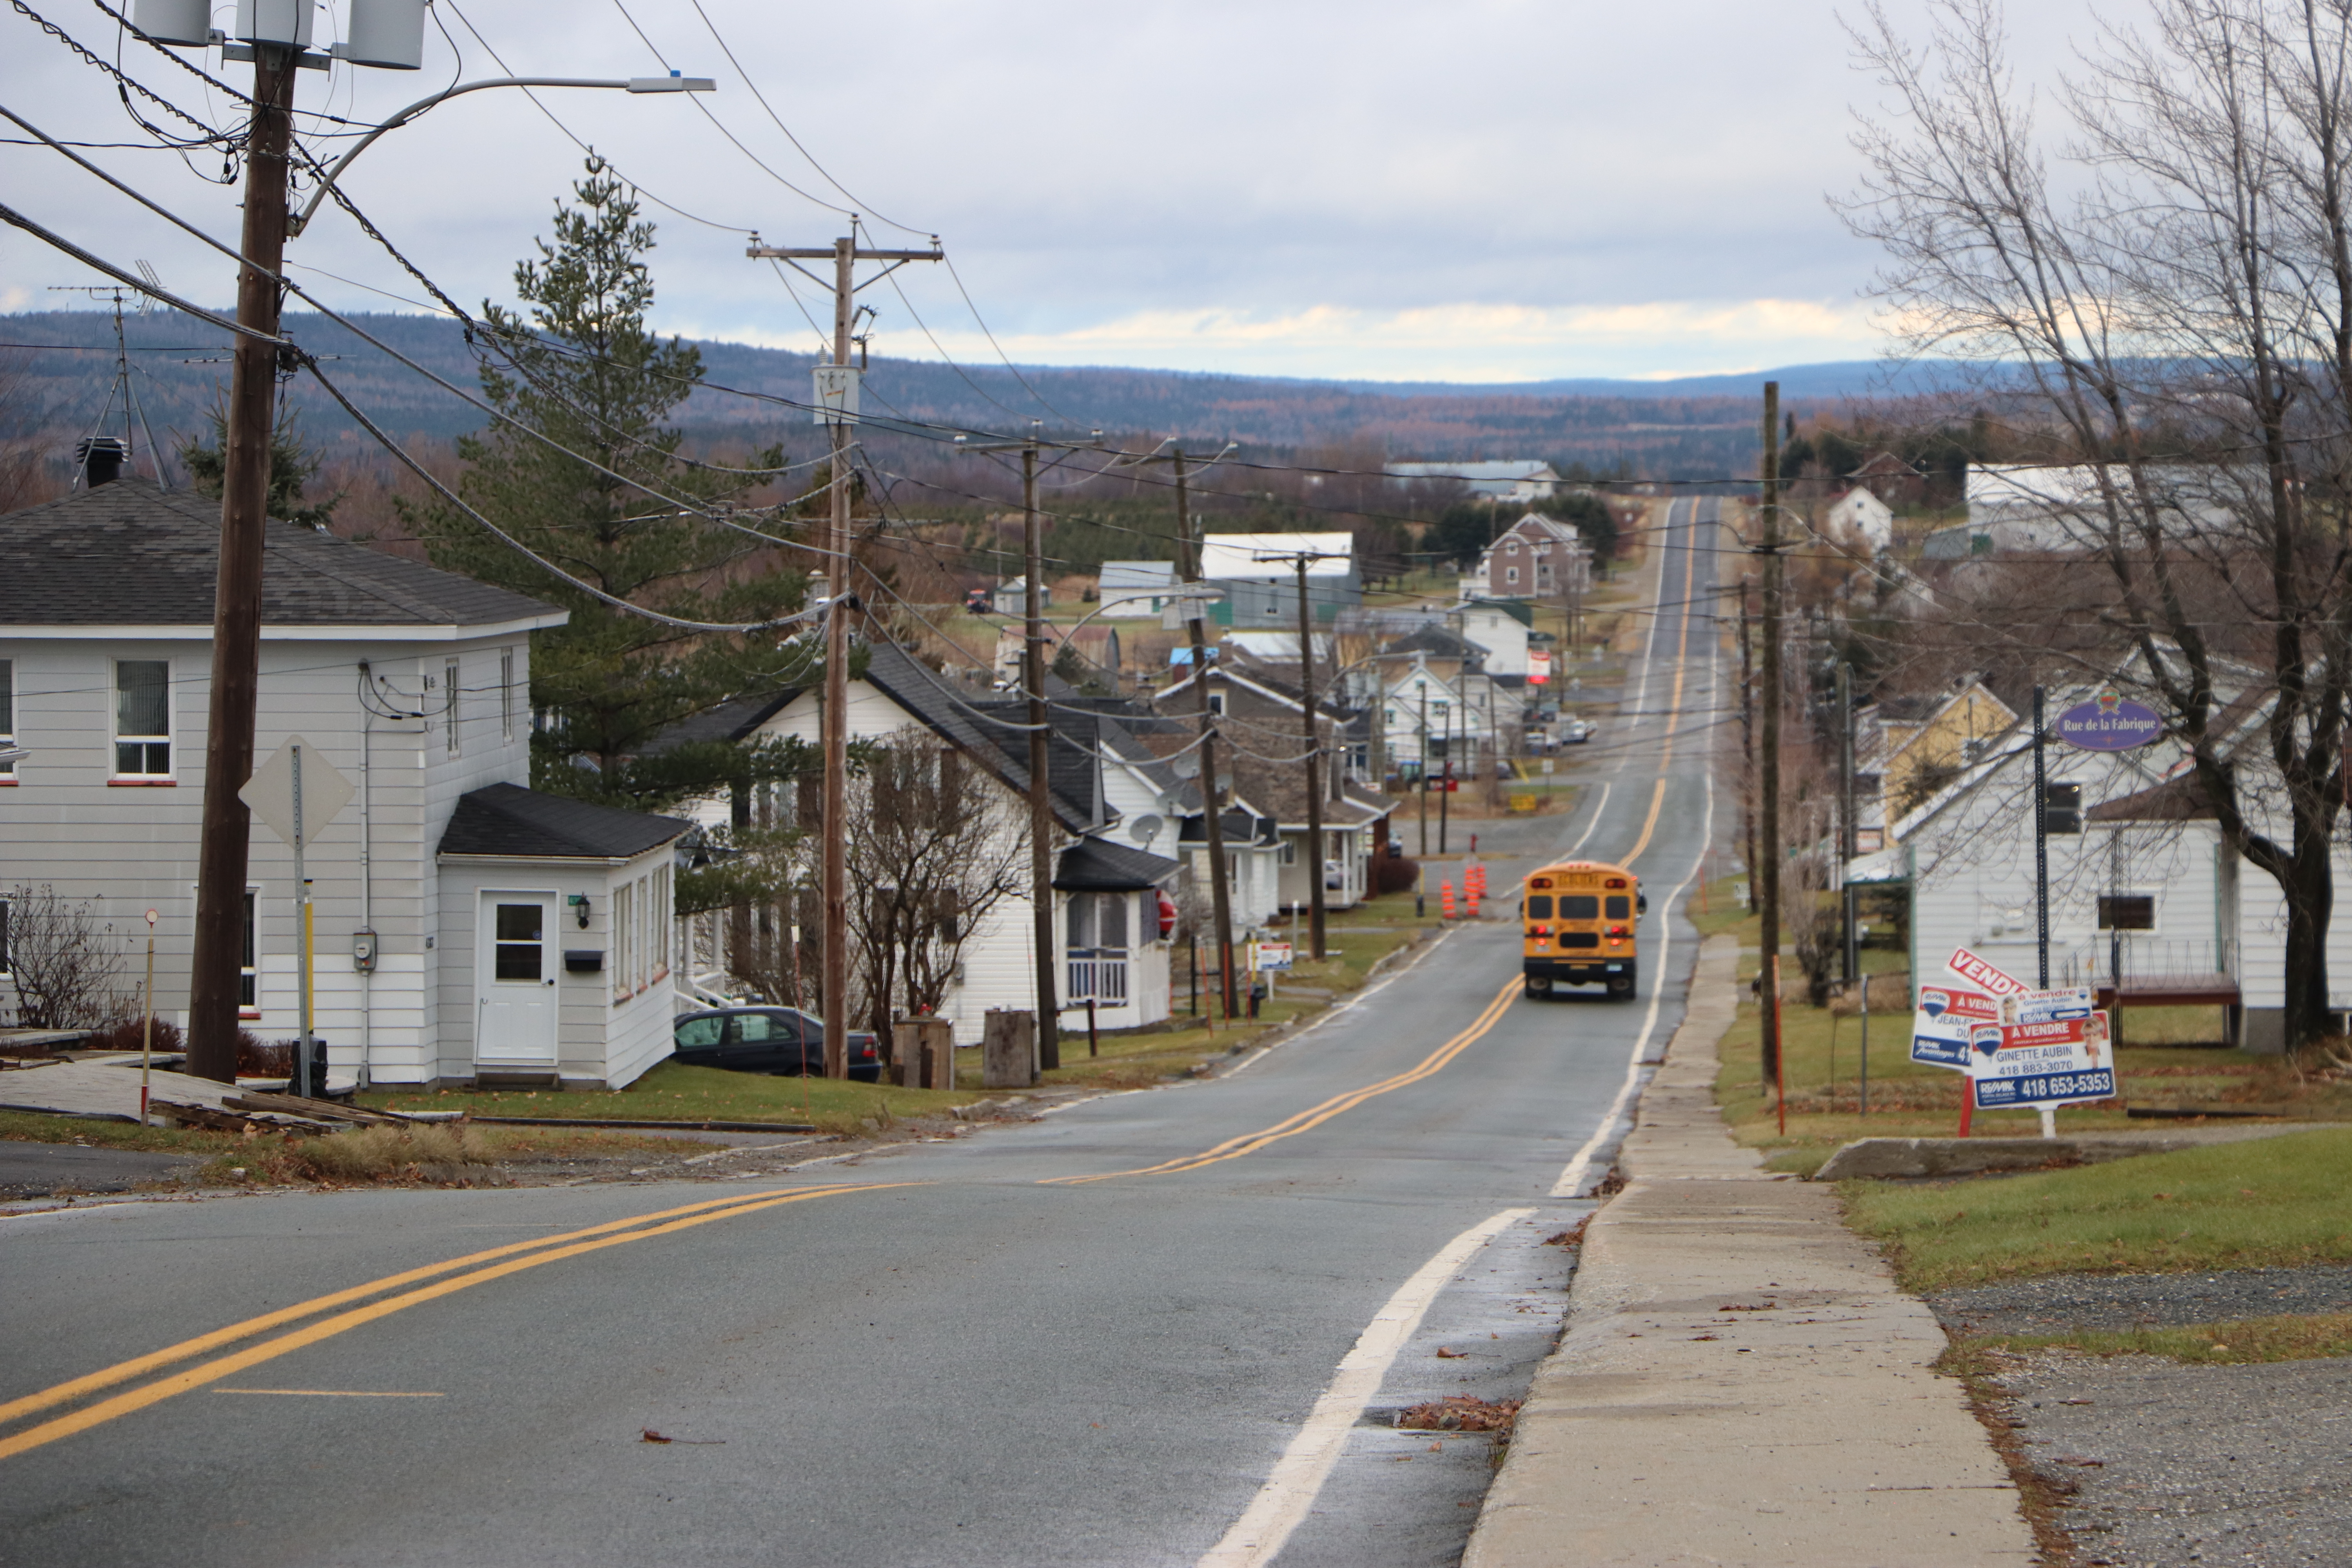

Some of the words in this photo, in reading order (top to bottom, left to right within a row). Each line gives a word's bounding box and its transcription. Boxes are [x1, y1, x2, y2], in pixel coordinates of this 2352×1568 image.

[2064, 720, 2083, 731] Rue
[2085, 718, 2098, 731] de
[2101, 718, 2110, 730] la
[2112, 717, 2156, 733] Fabrique
[2031, 989, 2076, 1000] vendre
[2024, 1022, 2070, 1037] VENDRE
[1997, 1049, 2039, 1062] GINETTE
[2042, 1046, 2072, 1058] AUBIN
[2000, 1066, 2019, 1076] 418
[2023, 1060, 2073, 1073] 883-3070
[1980, 1080, 2016, 1094] RE/MAX
[2022, 1078, 2047, 1097] 418
[2050, 1072, 2111, 1095] 653-5353
